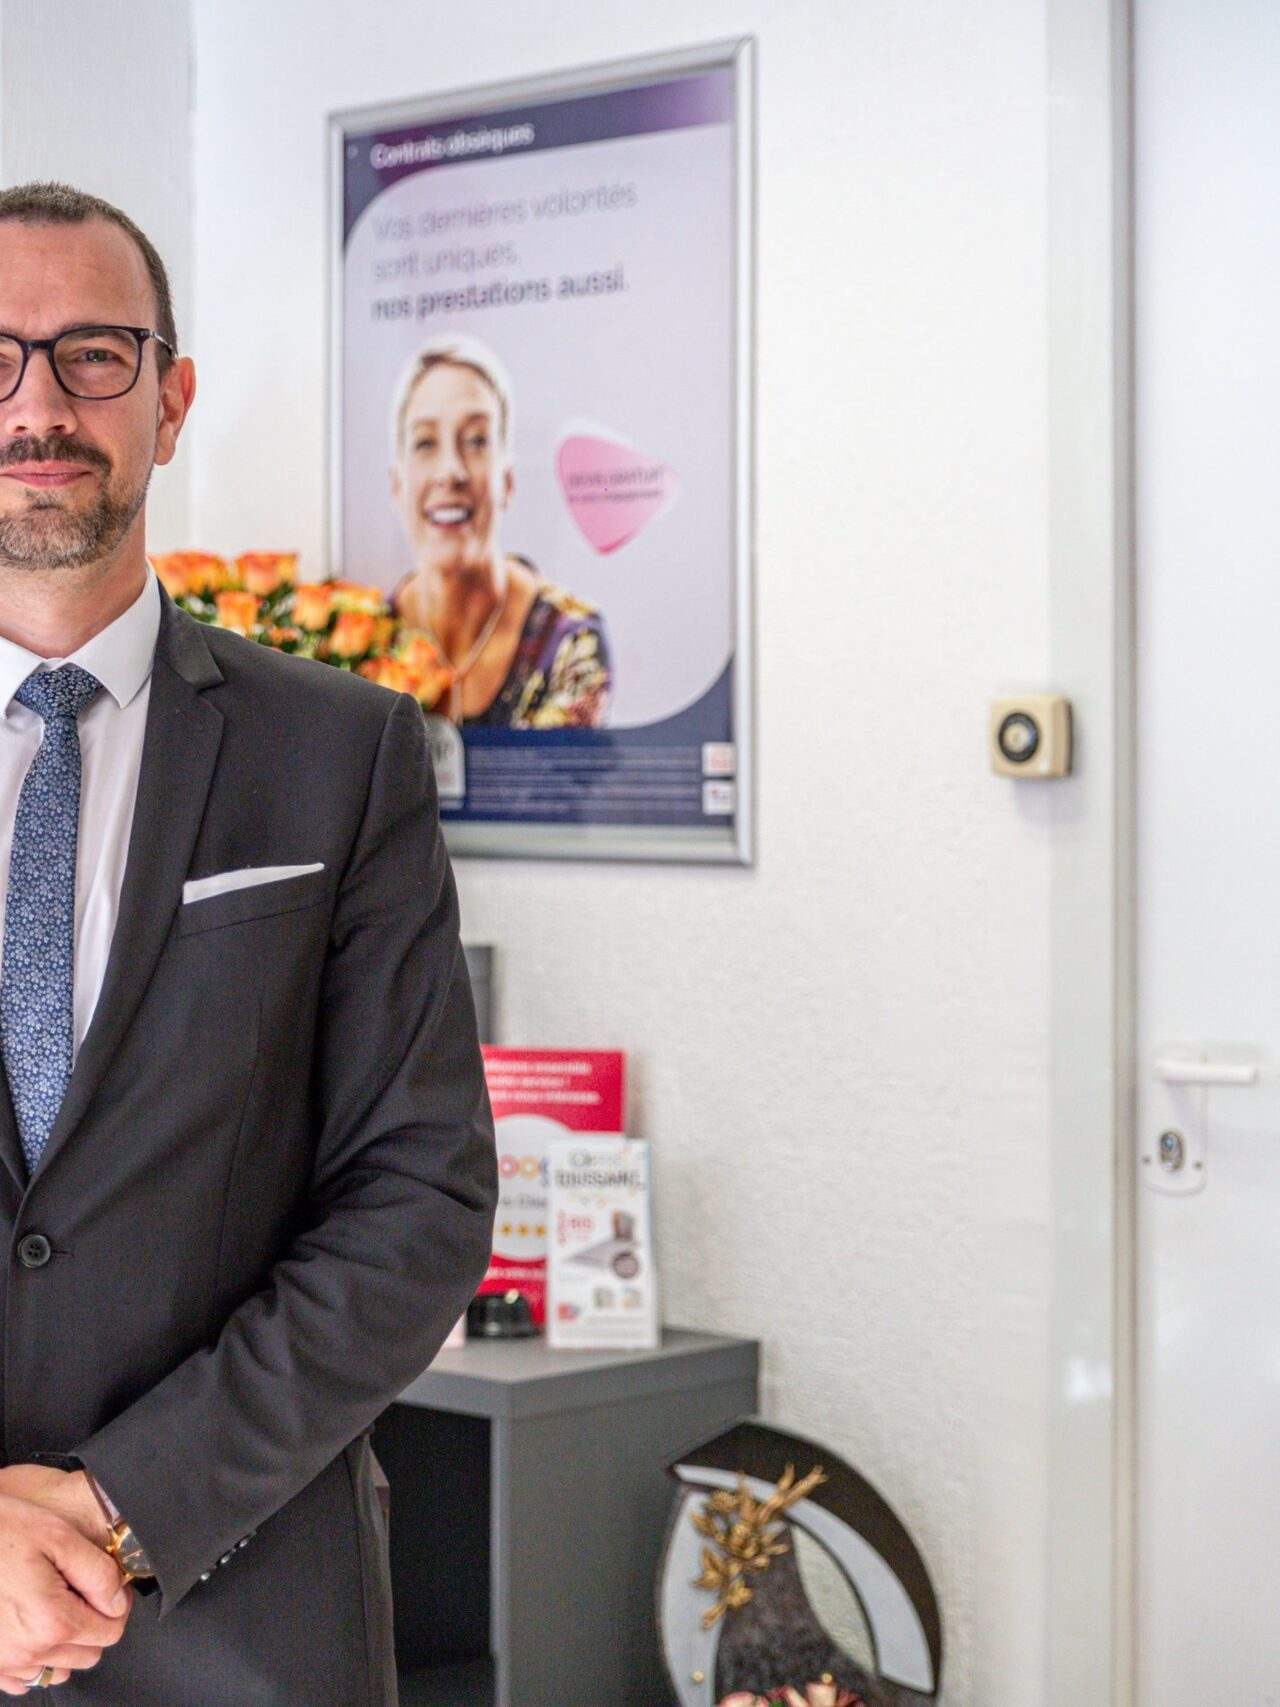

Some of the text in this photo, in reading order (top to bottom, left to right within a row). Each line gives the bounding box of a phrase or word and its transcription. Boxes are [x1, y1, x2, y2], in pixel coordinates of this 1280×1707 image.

[370, 136, 444, 169] Contrats
[373, 297, 413, 321] nos
[415, 275, 552, 321] prestations
